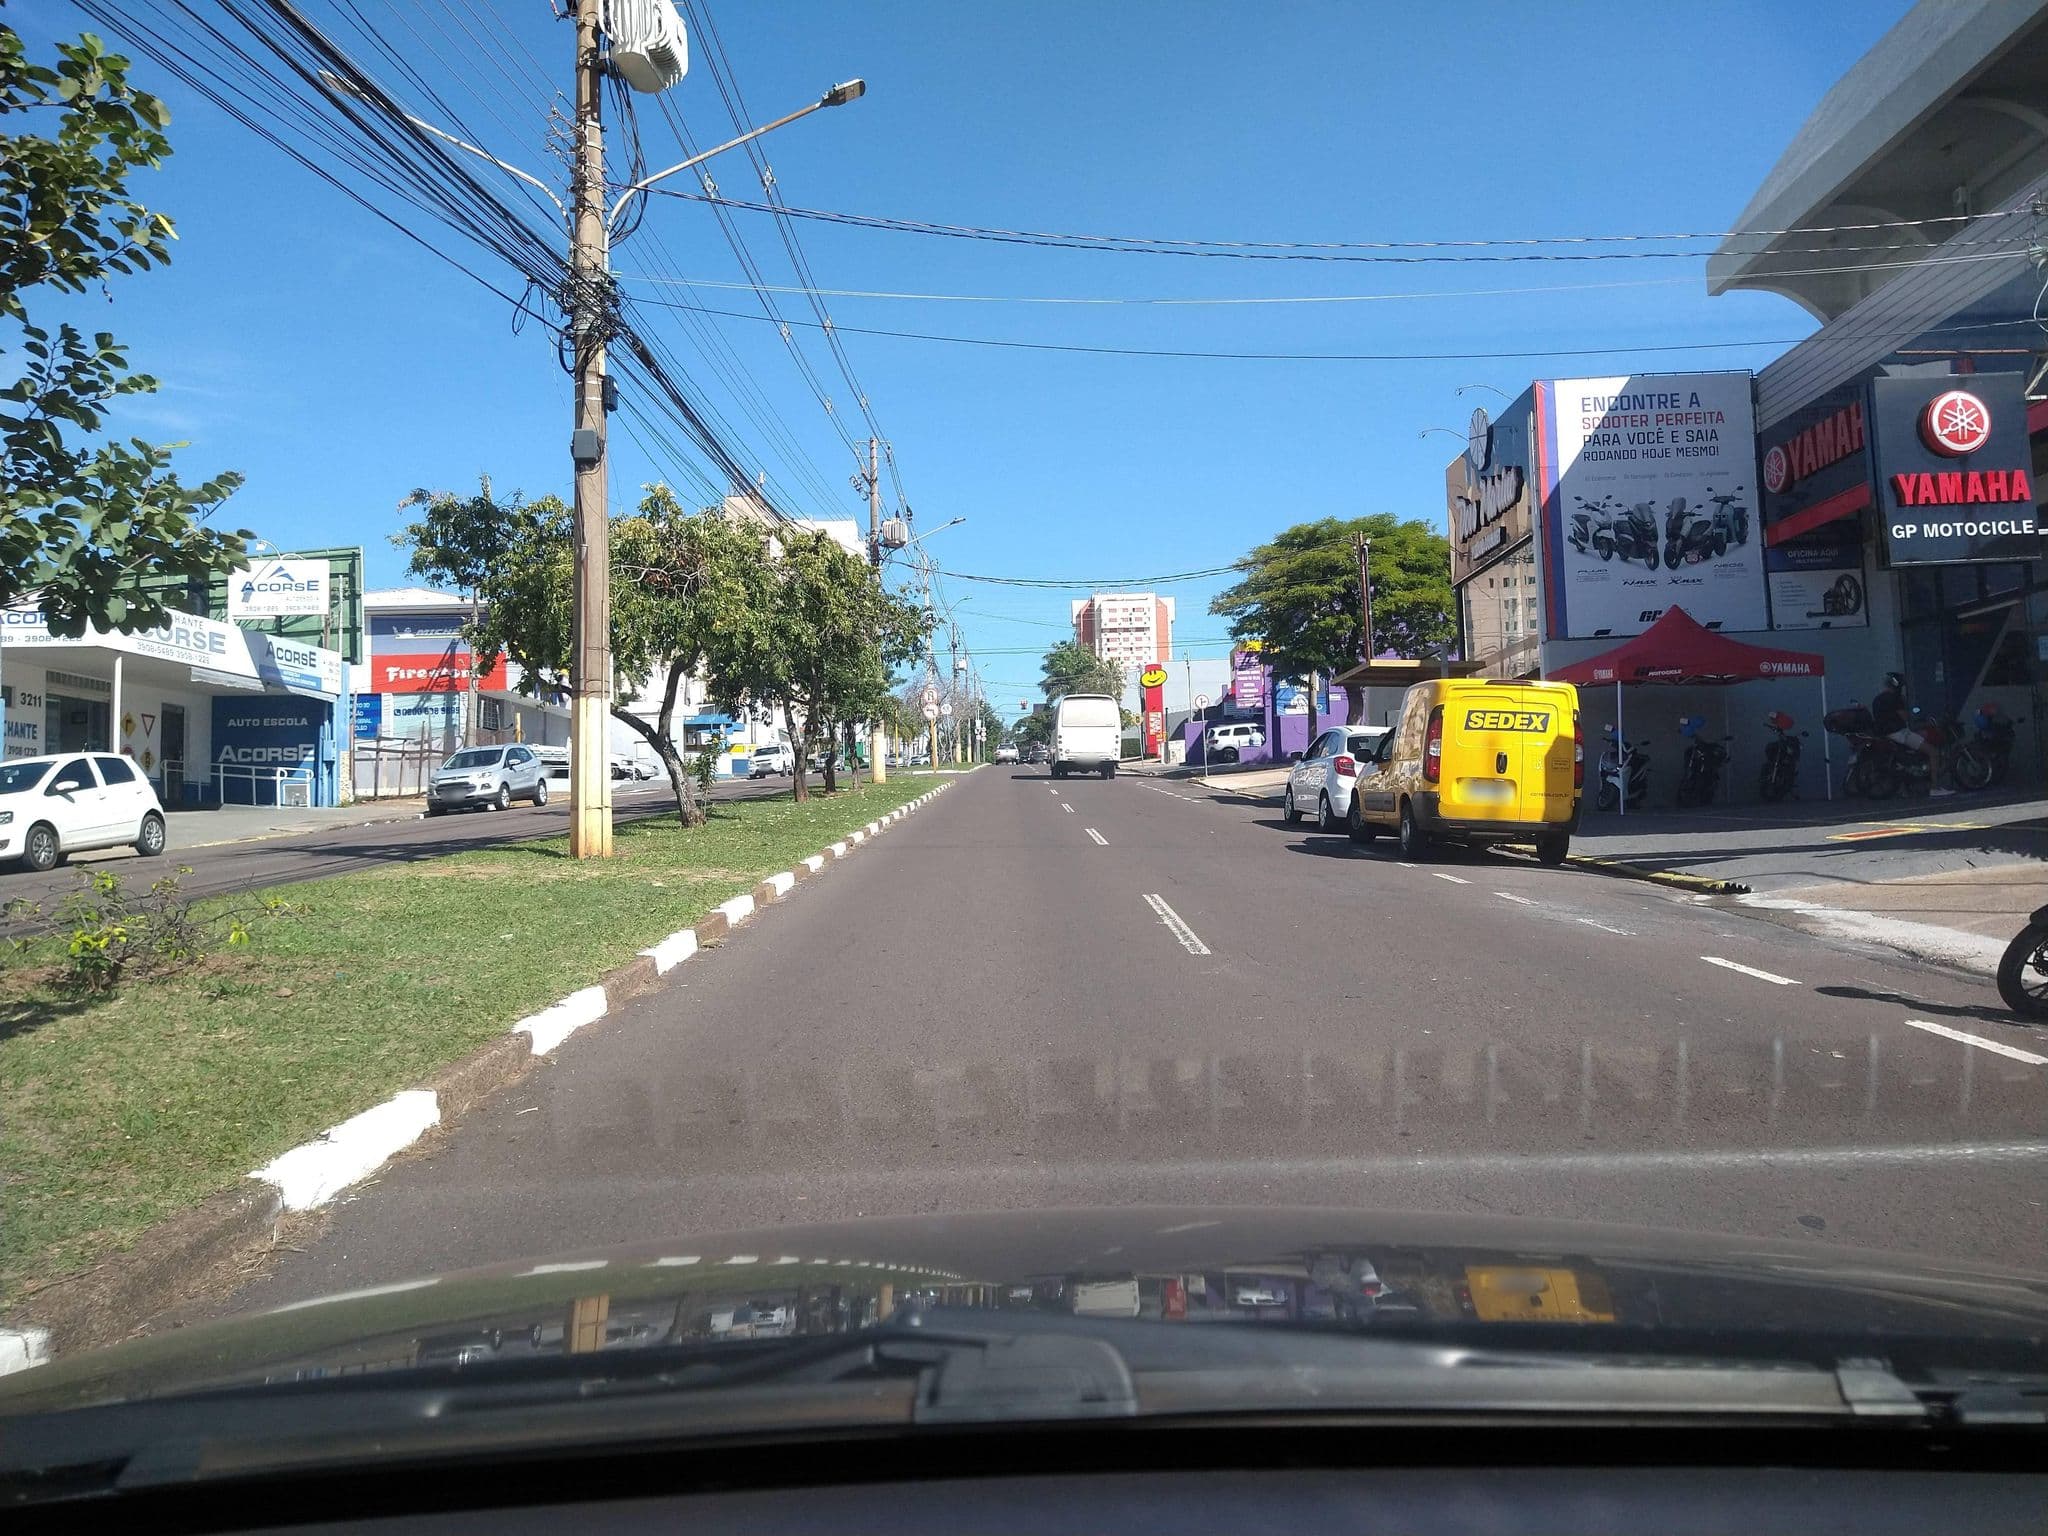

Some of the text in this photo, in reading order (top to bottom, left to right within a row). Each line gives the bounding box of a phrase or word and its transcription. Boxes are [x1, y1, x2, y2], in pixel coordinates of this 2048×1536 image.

[1581, 392, 1701, 412] ENCONTRE A
[1582, 411, 1725, 430] SCOOTER PERFEITA
[1583, 427, 1719, 447] PARA VOCÊ E SAIA
[1787, 400, 1864, 481] YAMAH
[1583, 445, 1719, 462] RODANDO HOJE MESMO!
[1897, 469, 2032, 506] YAMAHA
[1891, 519, 2035, 540] GP MOTOCICLE
[241, 581, 320, 592] ACORSE
[415, 628, 461, 636] MICHE
[265, 641, 317, 668] ACORSE
[386, 666, 484, 682] Fireston
[1770, 663, 1811, 673] YAMAHA
[20, 692, 42, 708] 3211
[227, 717, 308, 727] AUTO ESCOLA
[1468, 711, 1547, 731] SEDEX
[218, 743, 315, 762] ACORSE
